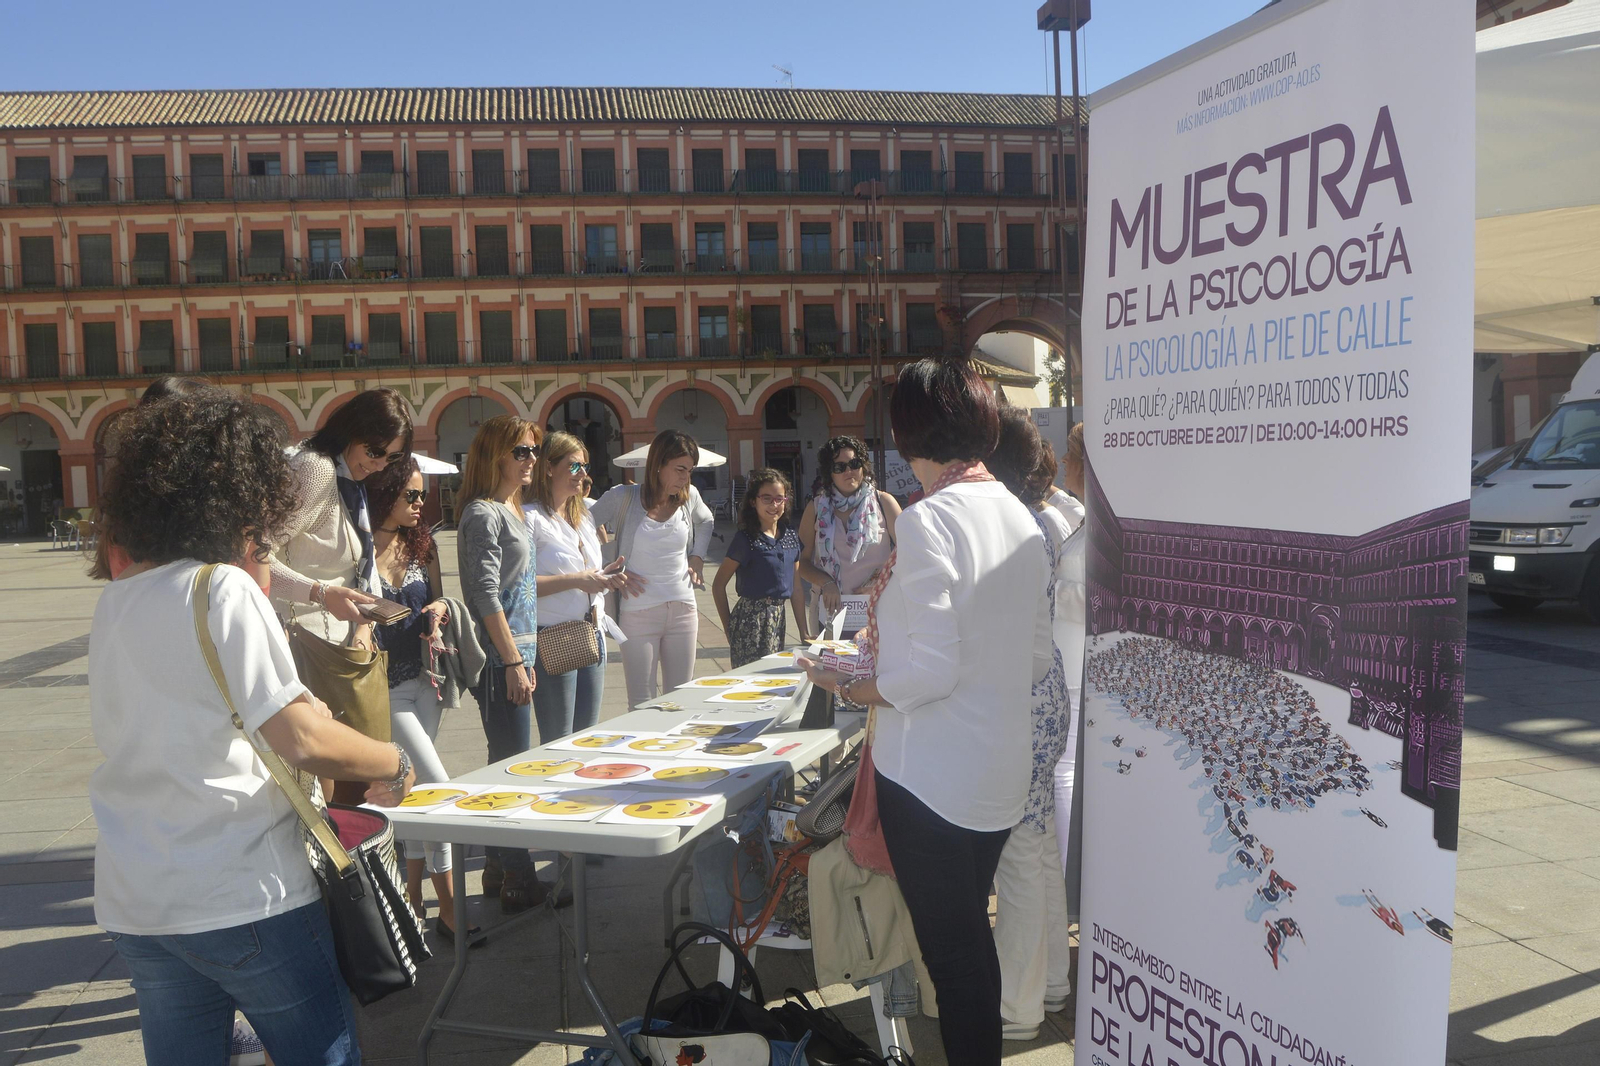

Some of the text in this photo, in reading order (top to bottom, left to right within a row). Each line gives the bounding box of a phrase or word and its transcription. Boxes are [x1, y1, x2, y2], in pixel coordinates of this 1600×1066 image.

[1198, 51, 1297, 106] UNA ACTIVIDAD GRATUITA
[1176, 112, 1193, 134] MÁS
[1109, 105, 1412, 278] MUESTRA
[1106, 222, 1412, 330] DE LA PSICOLOGÍA
[1105, 296, 1413, 381] LA PSICOLOGÍA A PIE DE CALLE
[1104, 369, 1409, 425] ¿PARA QUÉ? ¿PARA QUIÉN? PARA TODOS Y TODAS
[1104, 415, 1408, 448] 28 DE OCTUBRE DE 2017 DE 10:00-14:00 HRS
[1093, 922, 1354, 1066] INTERCAMBIO ENTRE LA CIUDADAN
[1091, 1007, 1120, 1060] DE
